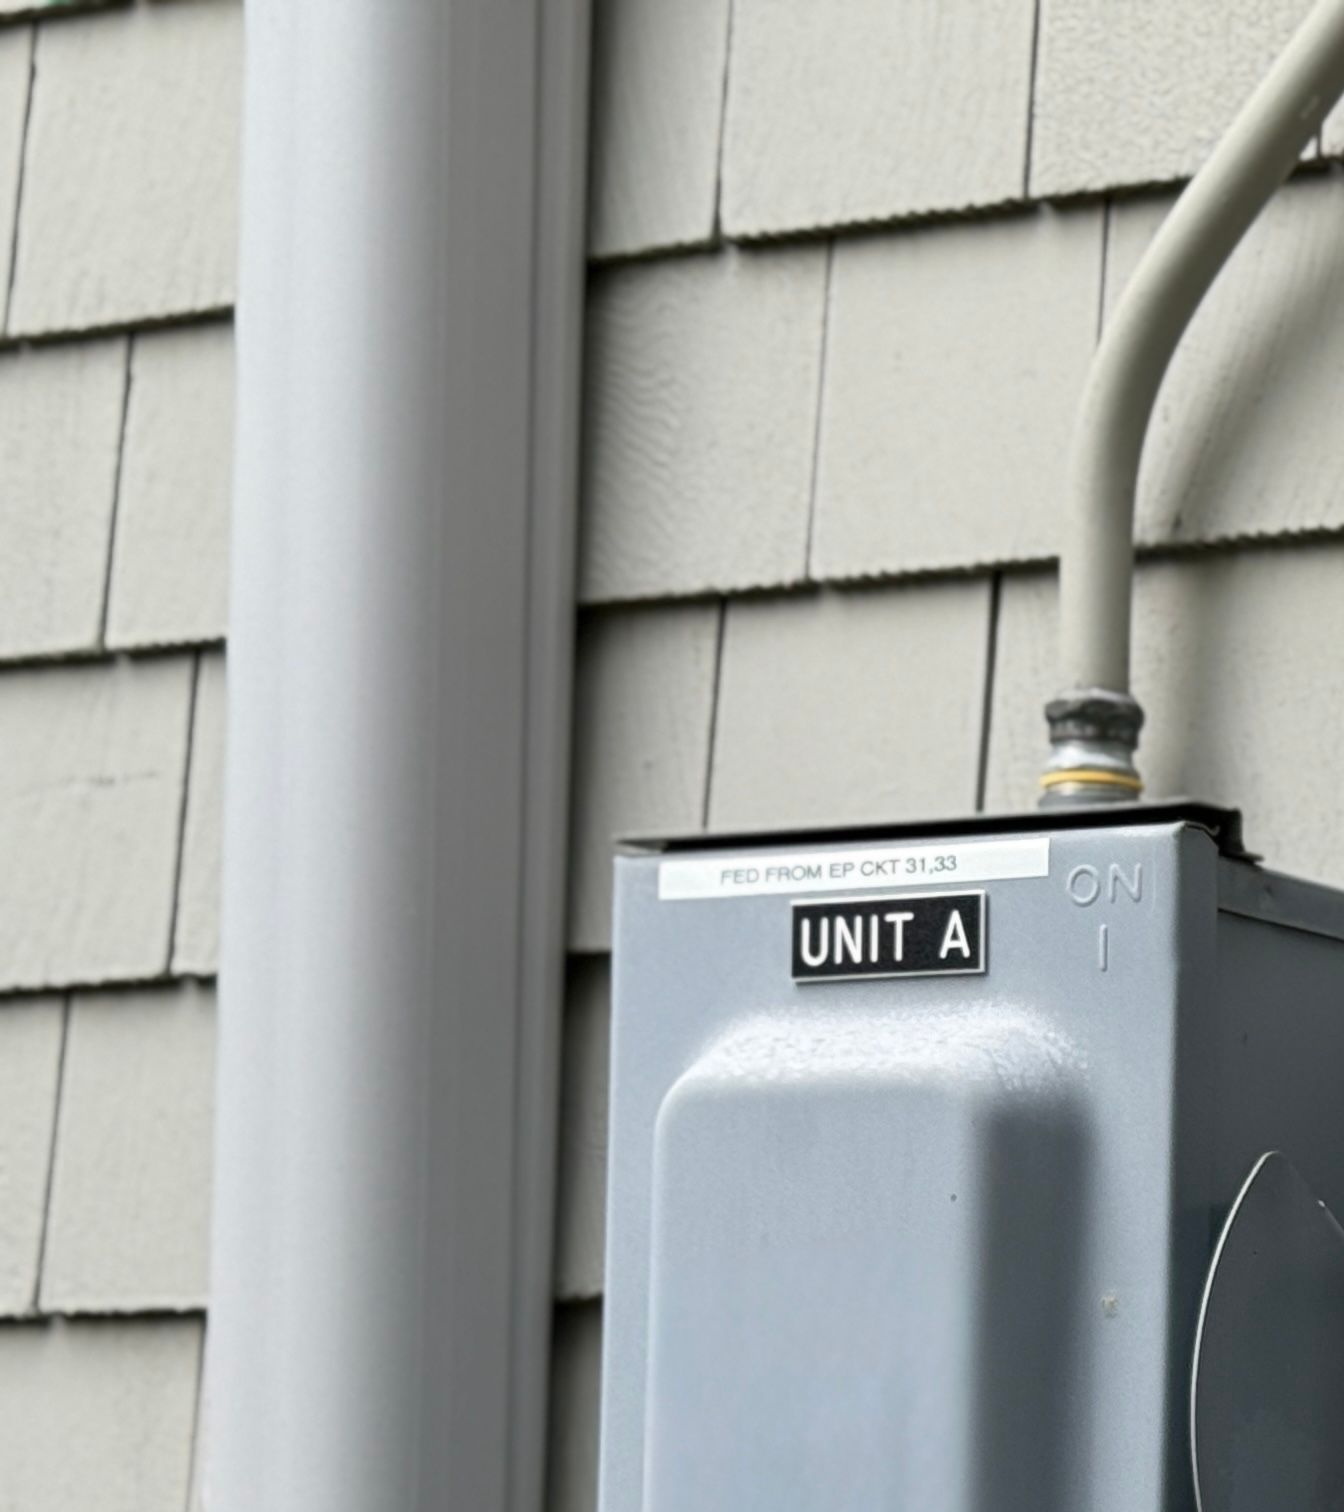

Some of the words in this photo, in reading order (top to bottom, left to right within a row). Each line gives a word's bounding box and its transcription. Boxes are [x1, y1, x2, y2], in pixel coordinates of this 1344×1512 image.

[720, 868, 760, 886] FED
[765, 864, 823, 883] FROM
[829, 862, 855, 879] EP
[860, 859, 901, 877] CKT
[905, 854, 957, 875] 31,33
[1065, 863, 1143, 908] ON
[801, 911, 915, 967] UNIT
[939, 909, 971, 960] A
